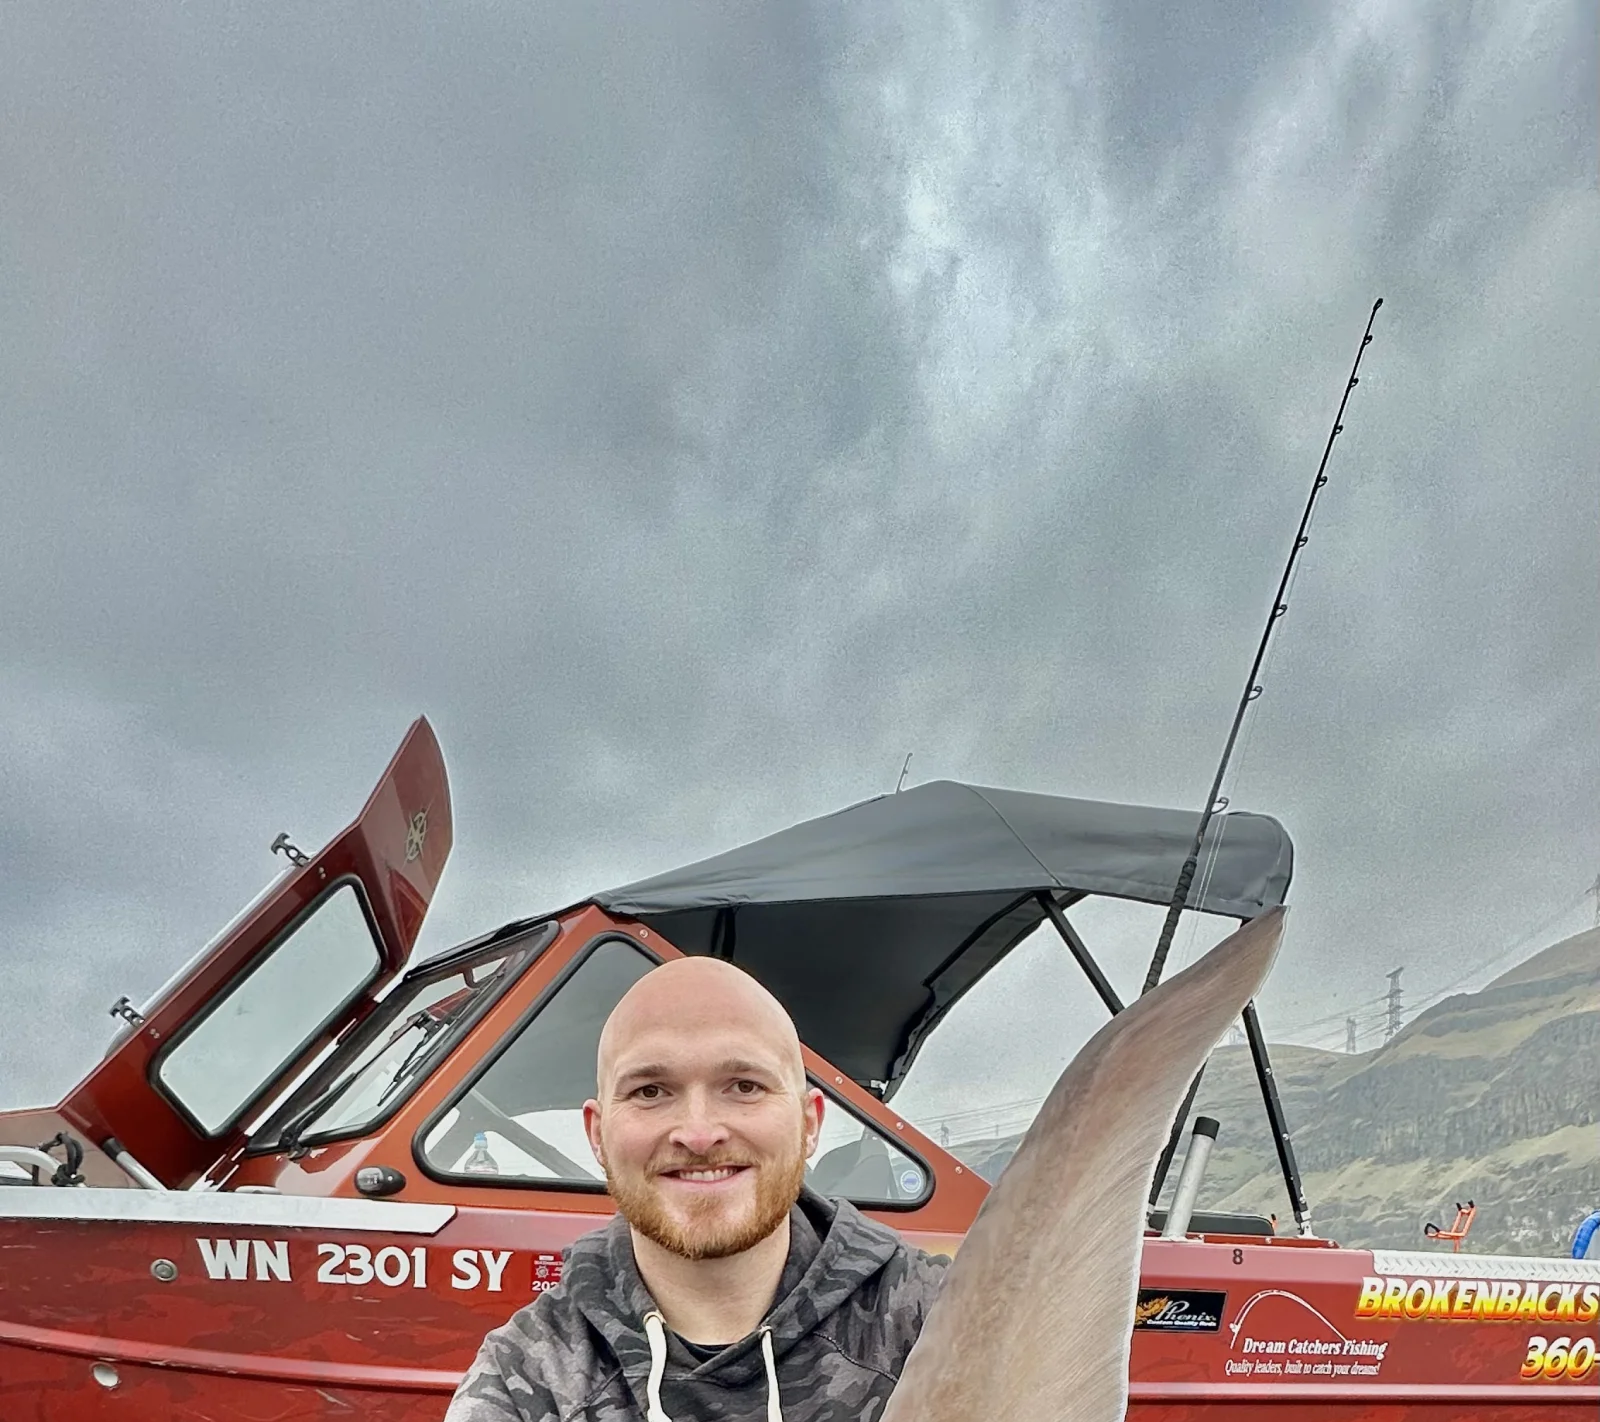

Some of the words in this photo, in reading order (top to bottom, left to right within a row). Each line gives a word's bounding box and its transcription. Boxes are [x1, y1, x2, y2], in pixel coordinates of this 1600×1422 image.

[196, 1238, 292, 1282] WN
[317, 1243, 428, 1288] 2301
[451, 1250, 514, 1292] SY
[1232, 1248, 1244, 1265] 8
[1355, 1276, 1600, 1321] BROKENBACKS
[1243, 1337, 1286, 1354] Dream
[1288, 1338, 1342, 1356] Catchers
[1342, 1340, 1388, 1360] Fishing
[1225, 1359, 1253, 1376] Quality
[1254, 1359, 1282, 1376] leaders,
[1284, 1360, 1303, 1374] built
[1303, 1362, 1312, 1374] to
[1312, 1360, 1332, 1375] catch
[1332, 1363, 1350, 1378] your
[1351, 1361, 1381, 1376] dreams!
